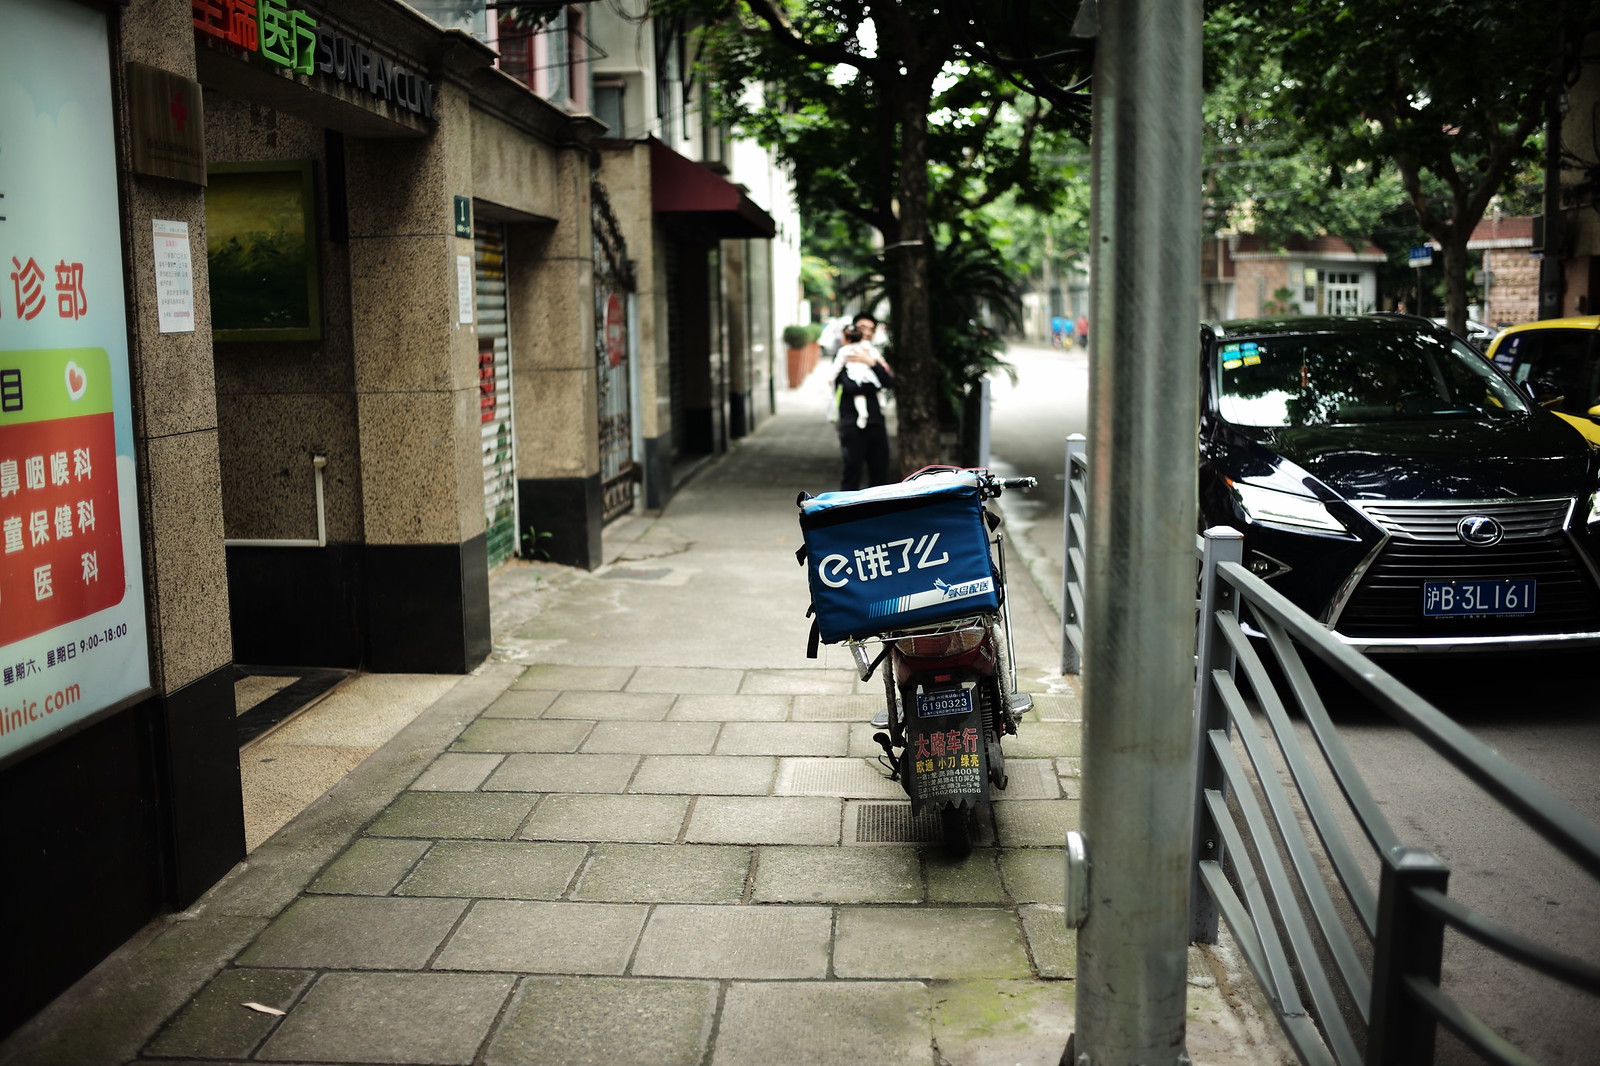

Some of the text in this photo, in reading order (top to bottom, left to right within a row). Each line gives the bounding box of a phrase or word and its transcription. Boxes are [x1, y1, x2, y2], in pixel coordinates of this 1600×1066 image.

[318, 26, 393, 101] SUNRAY
[0, 256, 87, 321] 诊部
[0, 448, 92, 498] 鼻咽喉科
[3, 499, 96, 554] 童保健科
[948, 580, 989, 599] 蜂鸟配送
[80, 623, 127, 653] 9:00-18:00
[922, 698, 968, 712] 6190323
[914, 728, 978, 759] 大路车行
[938, 756, 956, 770] 小刀
